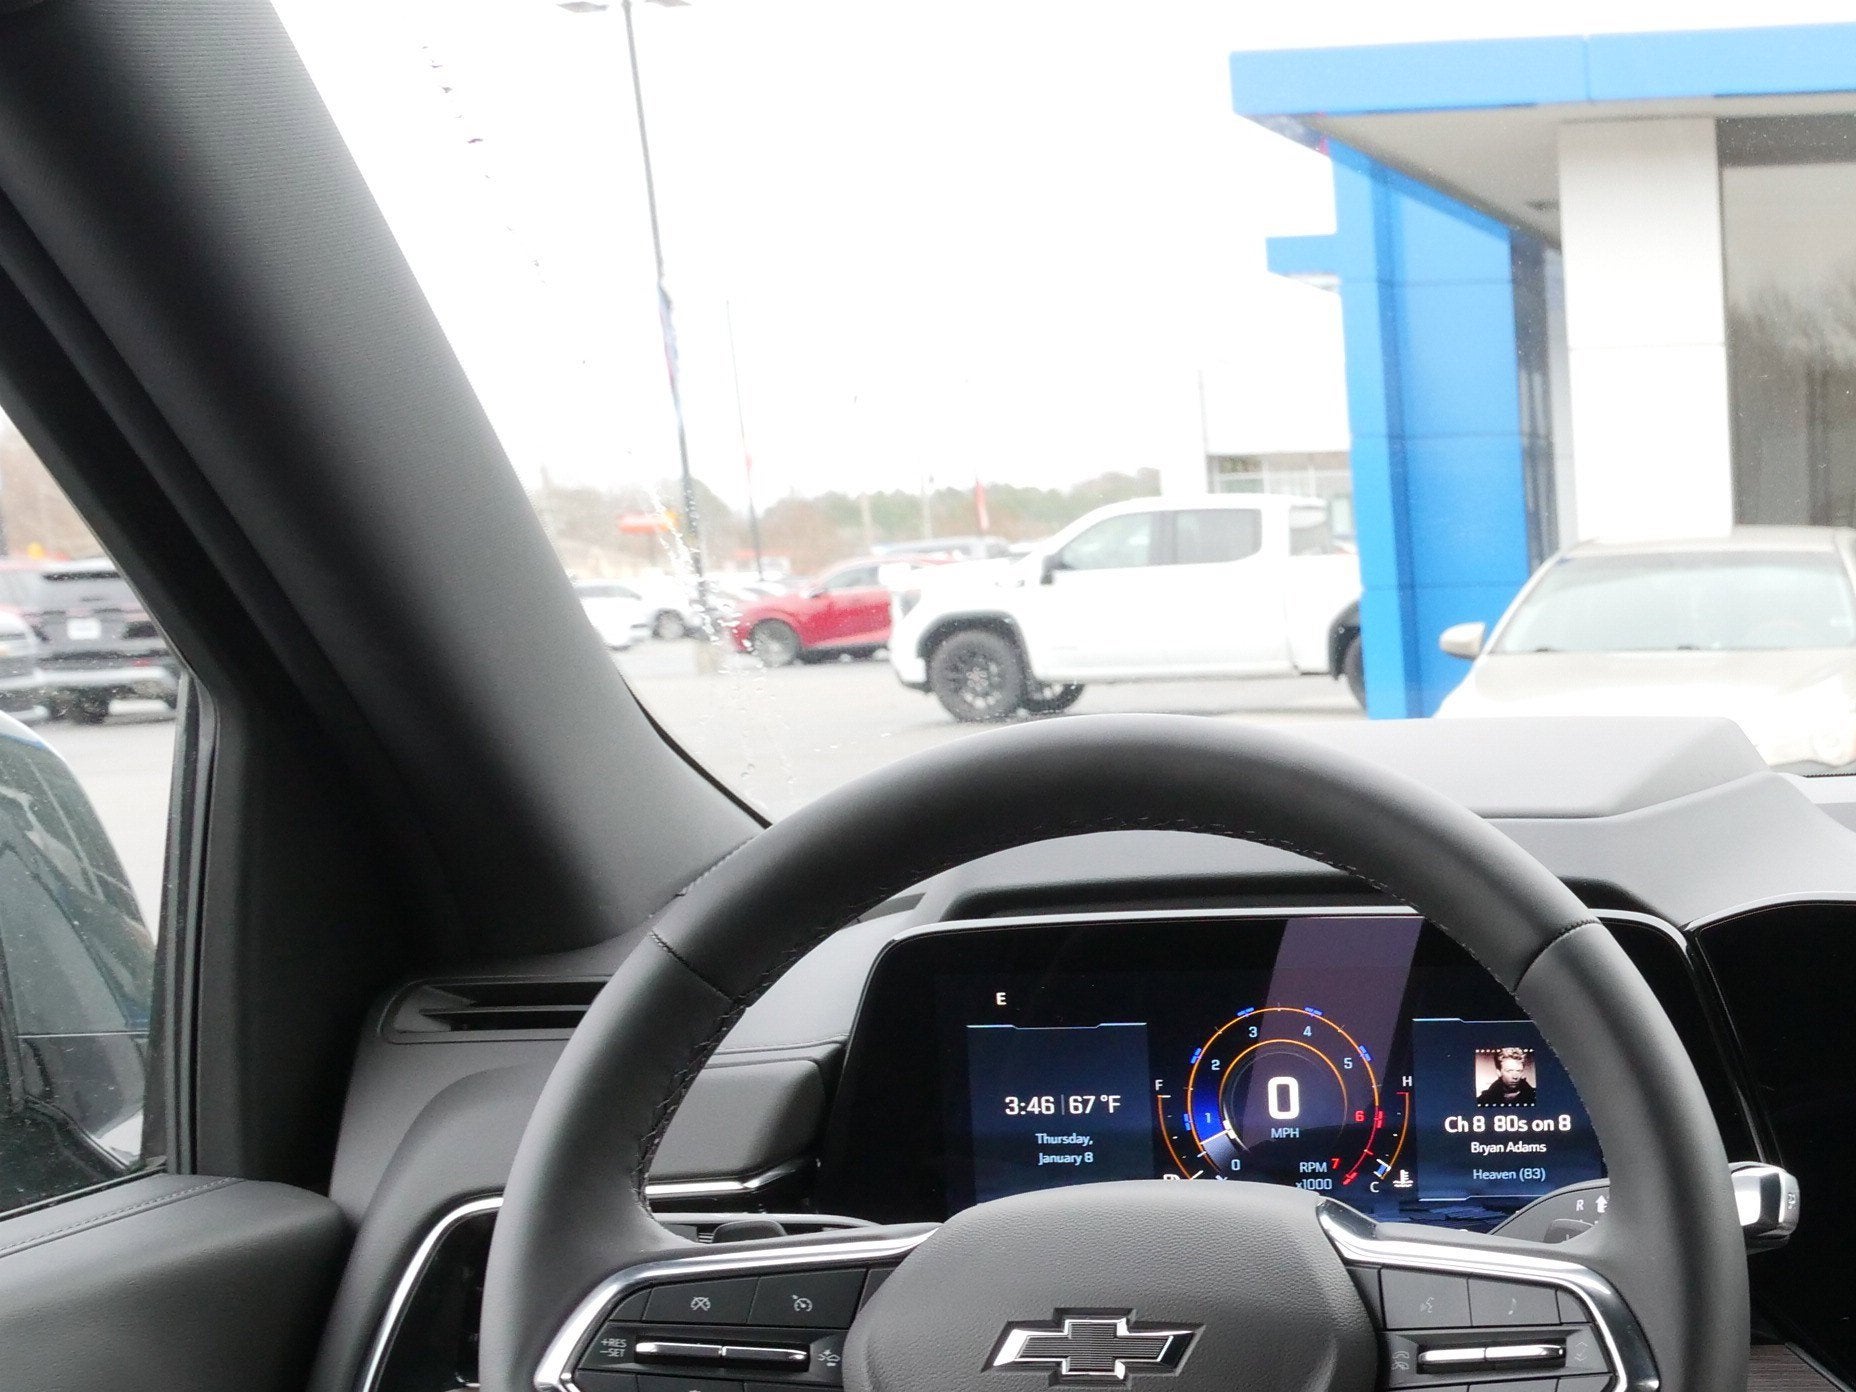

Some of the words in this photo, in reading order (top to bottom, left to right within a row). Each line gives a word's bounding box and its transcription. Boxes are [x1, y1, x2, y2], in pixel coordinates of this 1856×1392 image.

[995, 991, 1007, 1006] E
[1248, 1026, 1258, 1038] 3
[1302, 1026, 1312, 1037] 4
[1211, 1060, 1221, 1071] 2
[1343, 1058, 1353, 1069] 5
[1155, 1079, 1164, 1091] F
[1402, 1076, 1413, 1087] H
[1267, 1076, 1300, 1120] 0
[1004, 1096, 1055, 1115] 3:46
[1204, 1112, 1211, 1123] 1
[1354, 1110, 1365, 1122] 6
[1444, 1115, 1469, 1133] Ch
[1472, 1115, 1486, 1132] 8
[1493, 1115, 1529, 1132] 80s
[1531, 1118, 1555, 1132] on
[1558, 1114, 1572, 1132] 8
[1034, 1132, 1094, 1146] Thursday,
[1271, 1127, 1300, 1139] MPH
[1470, 1141, 1504, 1156] Bryan
[1506, 1140, 1547, 1153] Adams
[1038, 1152, 1082, 1166] January
[1083, 1151, 1094, 1163] 8
[1231, 1158, 1241, 1171] 0
[1331, 1157, 1340, 1170] 7
[1299, 1161, 1328, 1173] RPM
[1473, 1168, 1516, 1180] Heaven
[1519, 1167, 1546, 1182] (83)
[1369, 1181, 1380, 1193] C
[1576, 1199, 1585, 1212] R
